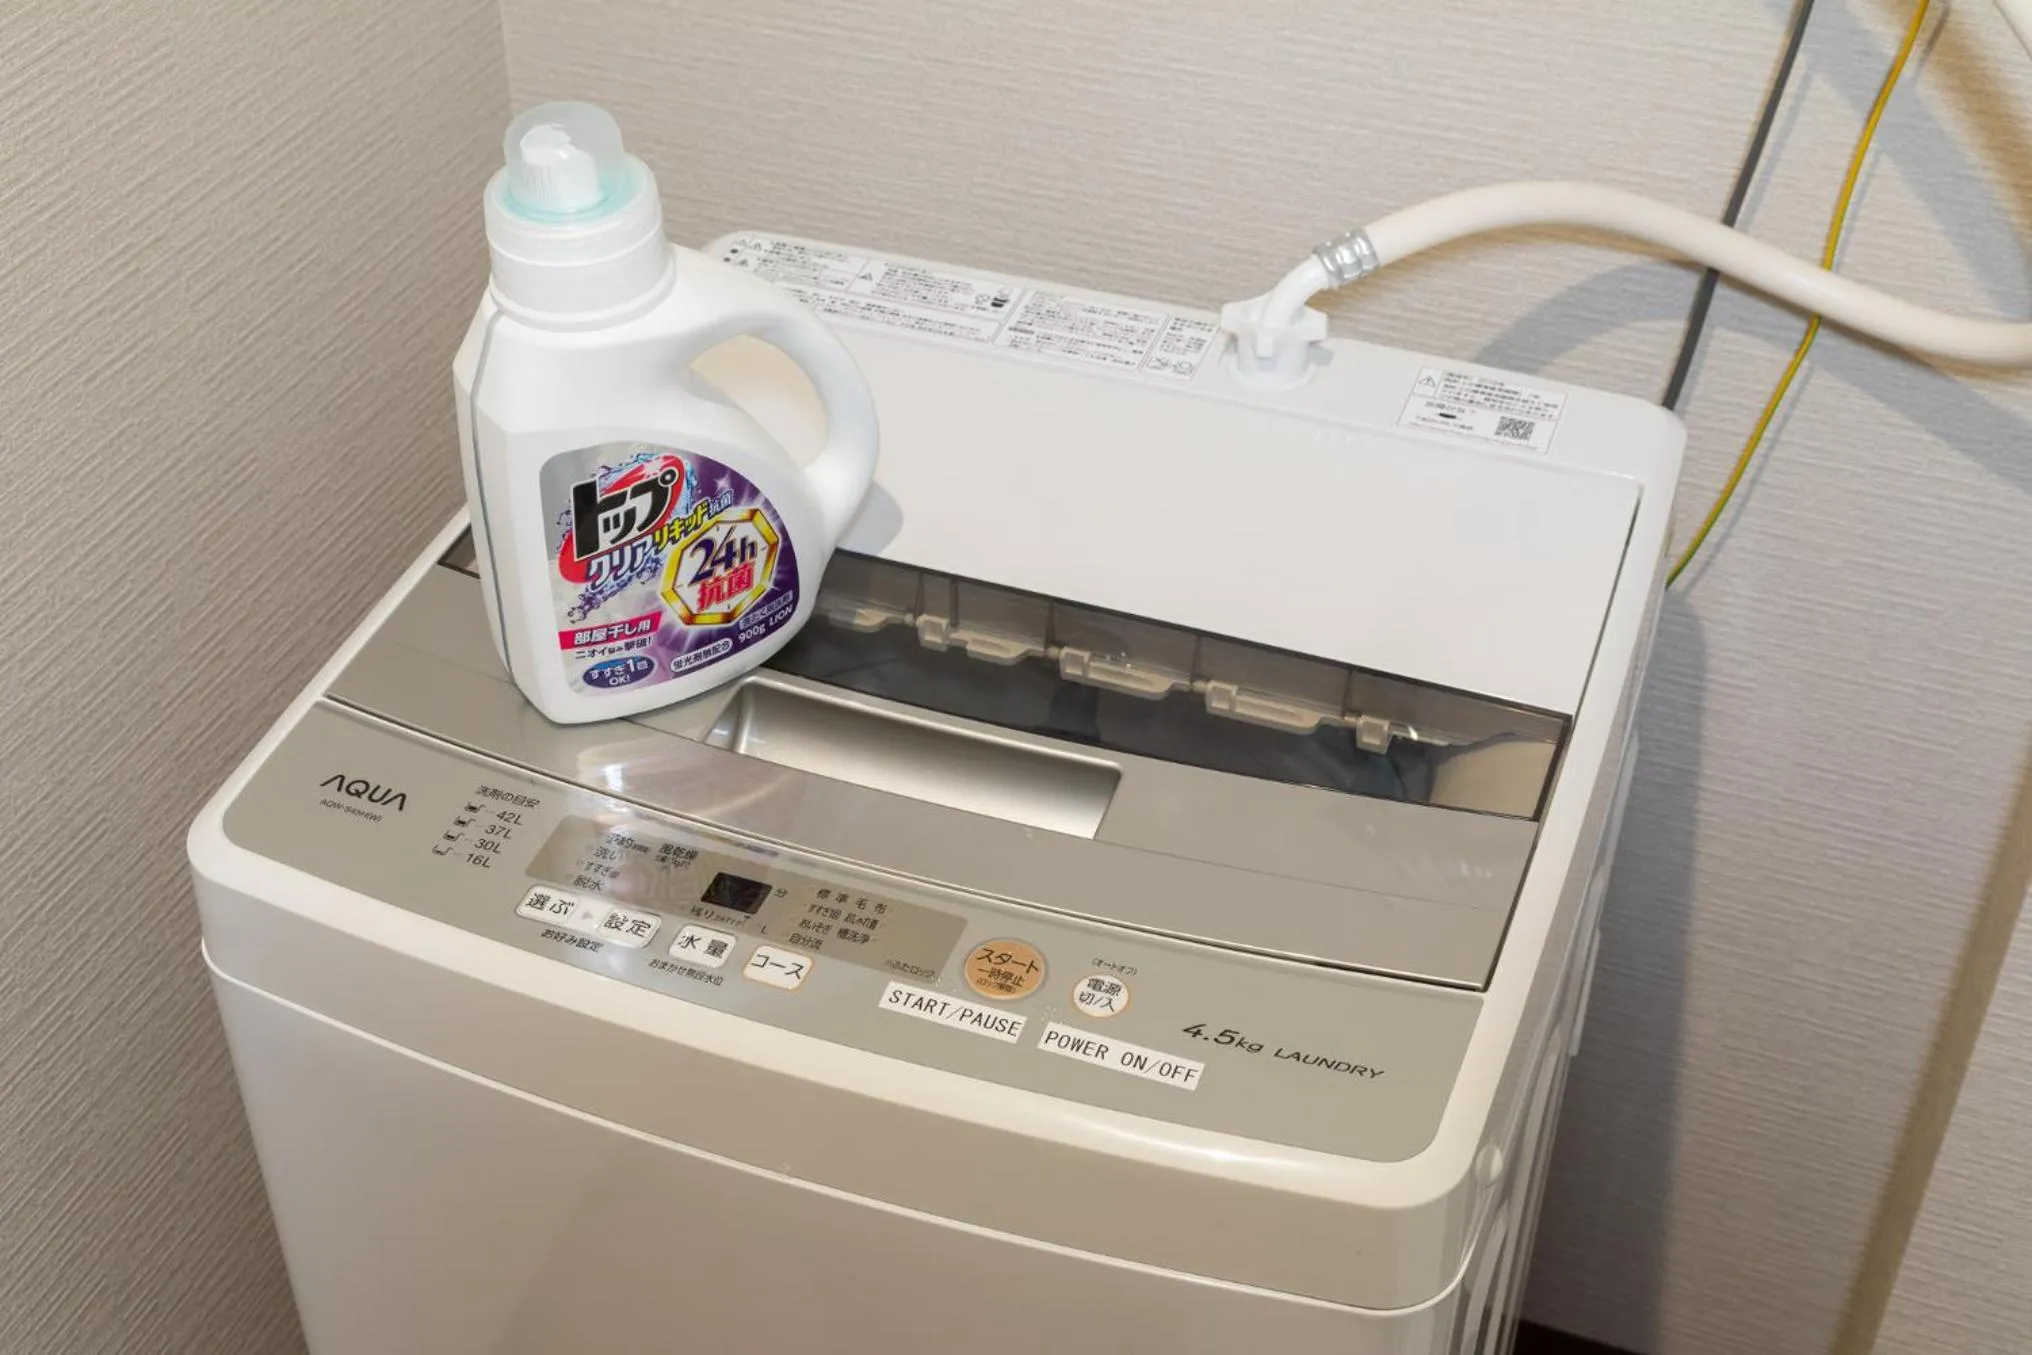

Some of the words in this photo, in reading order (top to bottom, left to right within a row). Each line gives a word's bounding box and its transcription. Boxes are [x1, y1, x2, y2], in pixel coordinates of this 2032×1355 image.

[572, 467, 677, 561] トップ
[687, 526, 757, 586] 24h
[699, 561, 756, 611] 抗菌
[574, 618, 652, 645] 部屋干し用
[738, 626, 765, 643] 900g
[769, 607, 793, 627] LION
[673, 641, 731, 671] 蛍光剤無配合
[608, 672, 630, 686] OK!
[320, 774, 408, 812] AQUA
[475, 784, 540, 809] 洗剤の目安
[496, 811, 523, 826] 42L
[484, 824, 512, 840] 37L
[474, 838, 502, 854] 30L
[466, 852, 491, 869] 16L
[526, 893, 575, 916] 選ぶ
[855, 895, 888, 913] 毛布
[603, 912, 652, 938] 設定
[541, 928, 604, 953] お好み設定
[678, 933, 730, 959] 水量
[751, 952, 806, 981] コース
[976, 947, 1040, 974] スタート
[976, 965, 1025, 988] 一時停止
[1086, 976, 1123, 997] 電源
[887, 988, 1021, 1038] START/PAUSE
[1079, 989, 1116, 1013] 切/入
[1043, 1030, 1110, 1061] POWER
[1120, 1050, 1199, 1084] ON/OFF
[1183, 1023, 1264, 1054] 4.5kg
[1273, 1048, 1384, 1081] LAUNDRY
